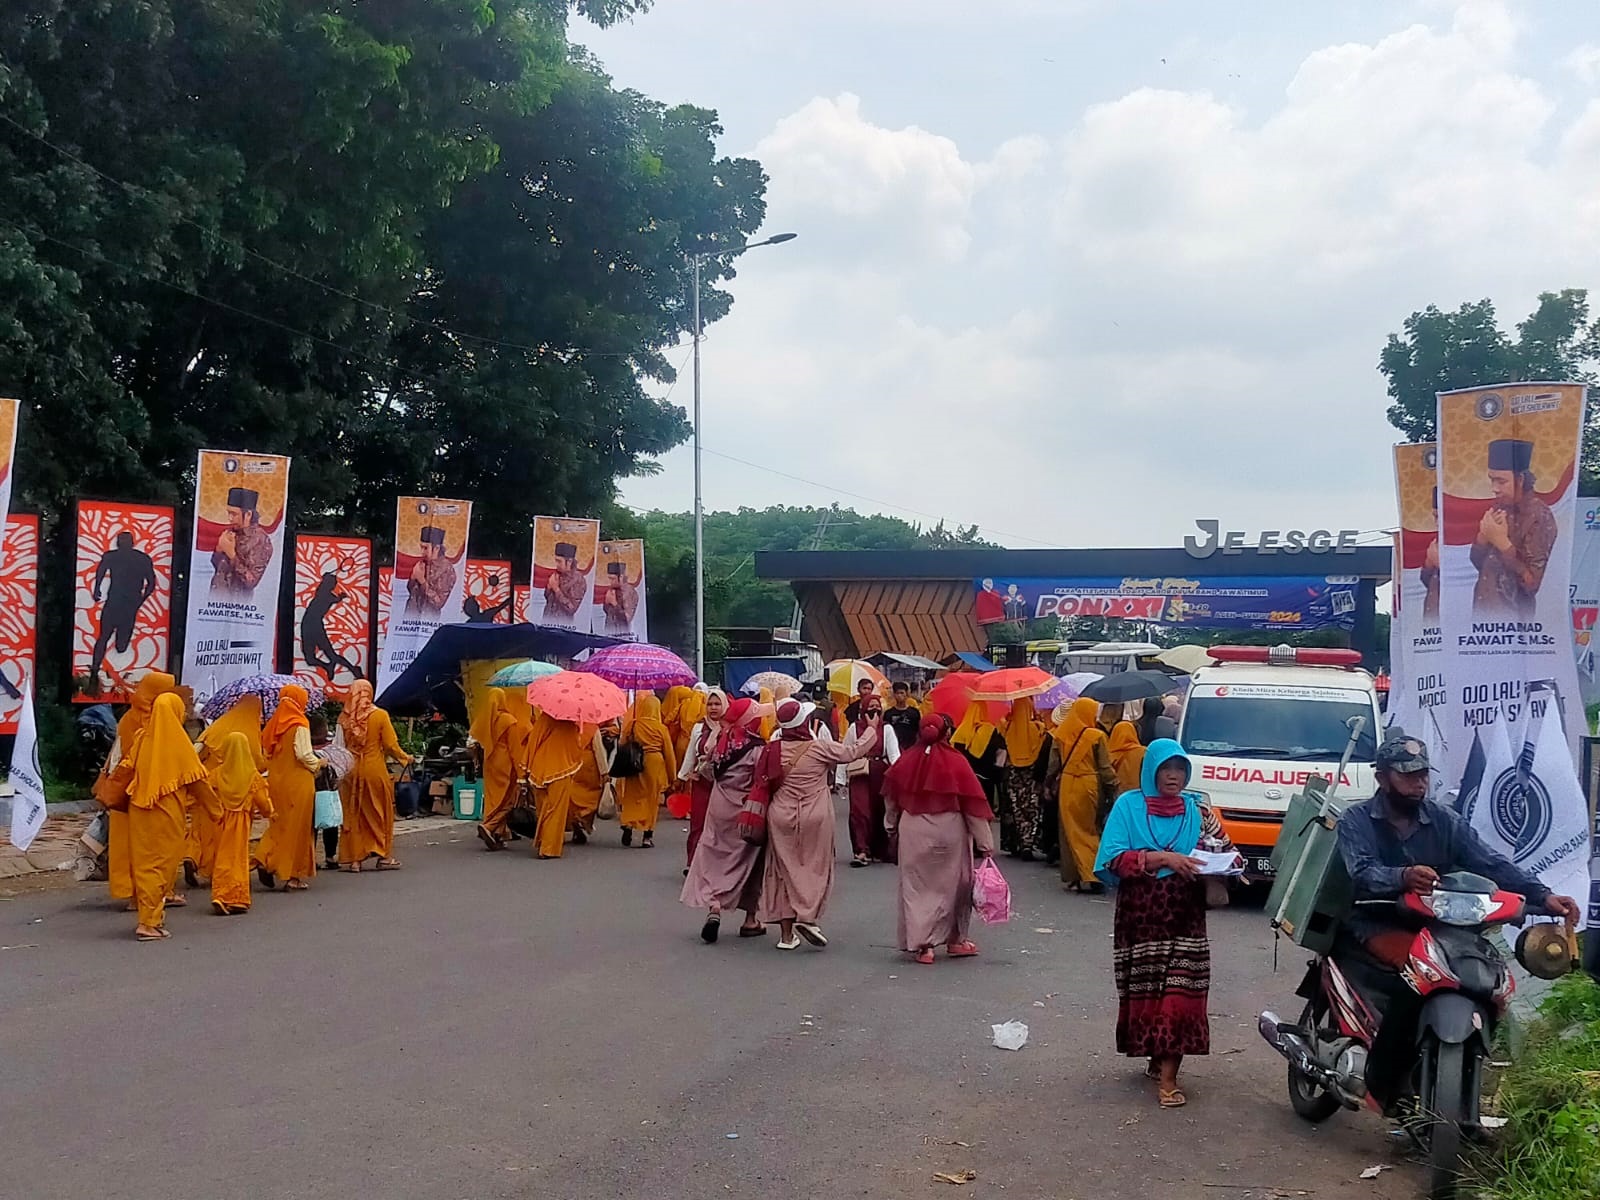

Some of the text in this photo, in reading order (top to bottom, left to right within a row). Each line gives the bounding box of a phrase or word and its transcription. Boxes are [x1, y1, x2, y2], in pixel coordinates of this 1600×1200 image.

[1036, 595, 1104, 619] PON
[197, 640, 214, 653] OJO
[1458, 634, 1516, 646] FAWAIT
[195, 654, 220, 666] MOCO
[391, 651, 405, 661] OJO
[1417, 674, 1436, 692] OJO
[1418, 690, 1447, 710] MOCO
[1462, 684, 1489, 705] OJO
